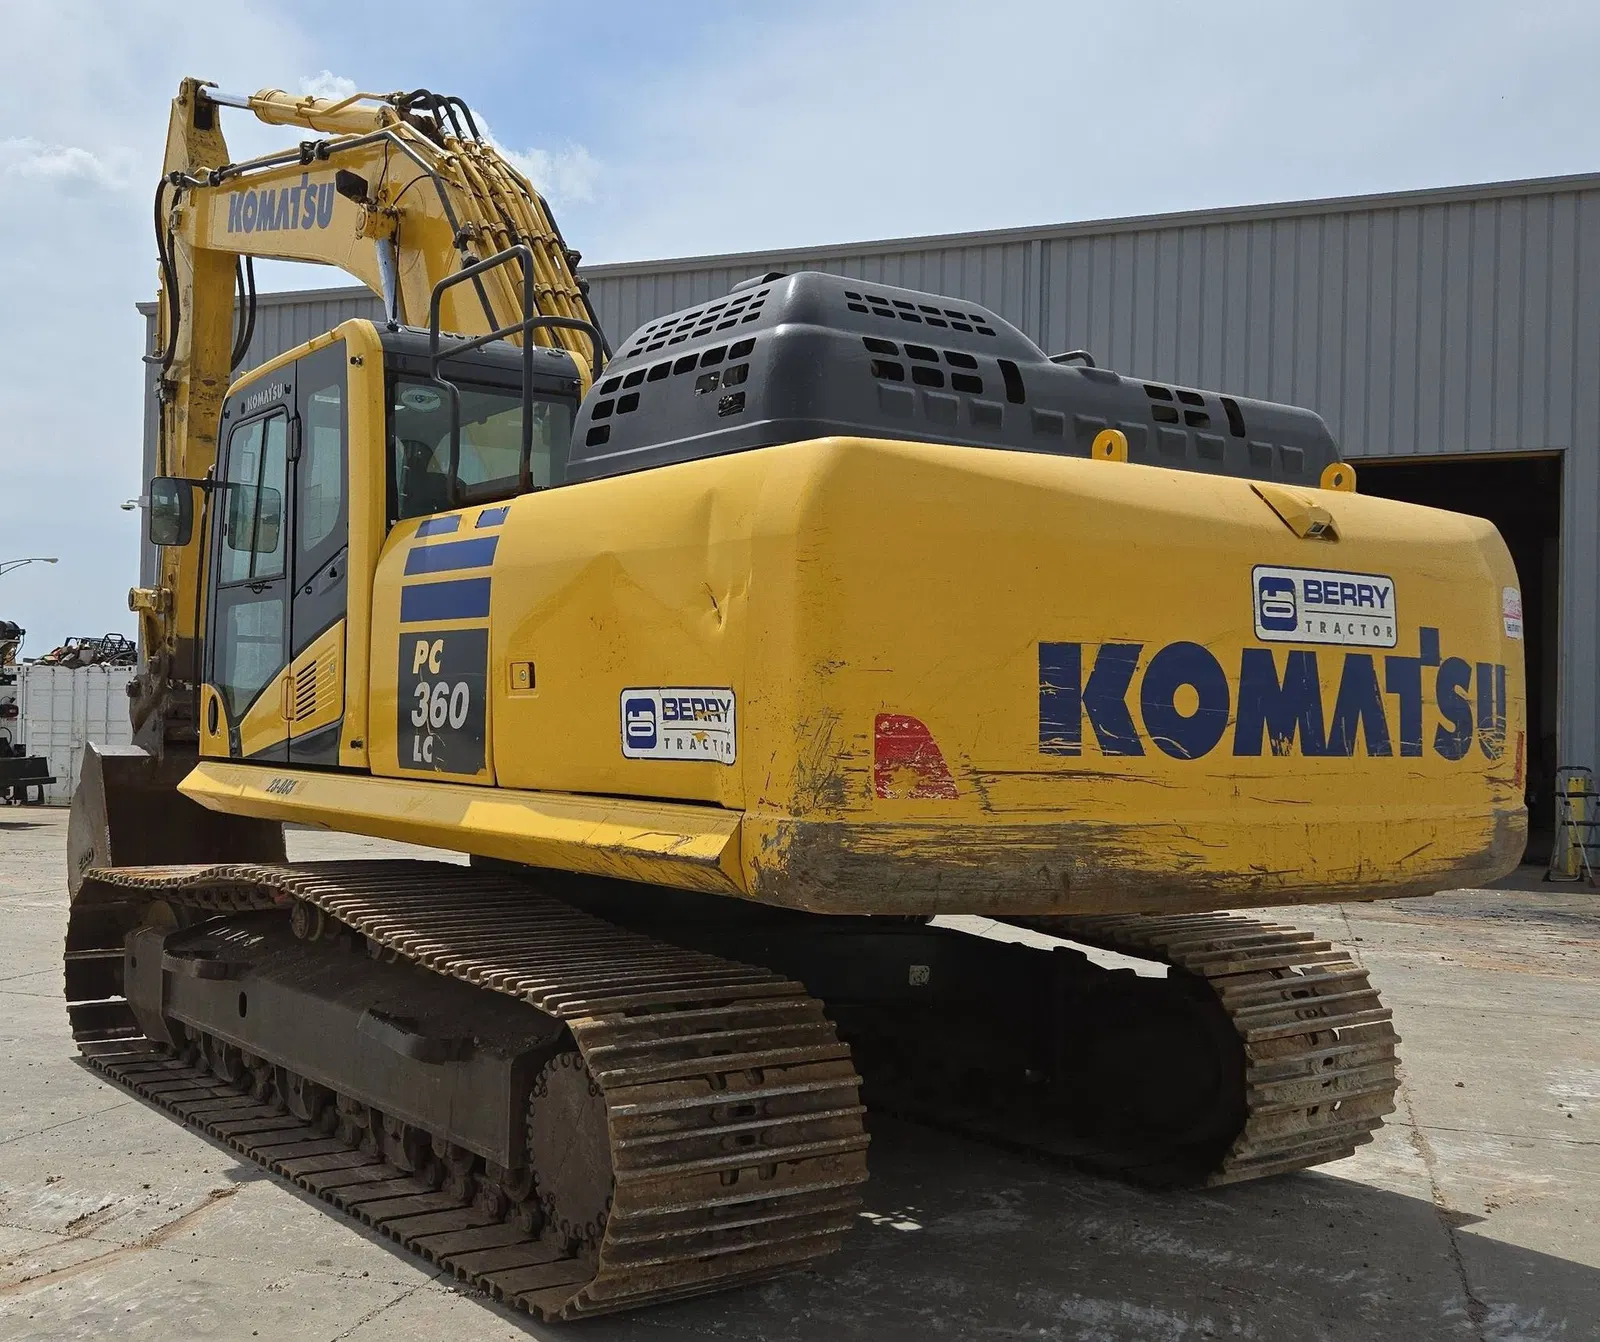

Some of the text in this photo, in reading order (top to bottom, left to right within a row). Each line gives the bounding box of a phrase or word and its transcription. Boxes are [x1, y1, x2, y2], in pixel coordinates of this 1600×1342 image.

[228, 172, 335, 233] KOMATSU
[247, 382, 283, 411] KOMATSU
[1303, 579, 1390, 609] BERRY
[1305, 620, 1393, 638] TRACTOR
[412, 639, 444, 674] PC
[411, 681, 470, 730] 360
[1038, 626, 1506, 761] KOMATSU
[662, 697, 732, 723] BERRY
[413, 735, 434, 763] LC
